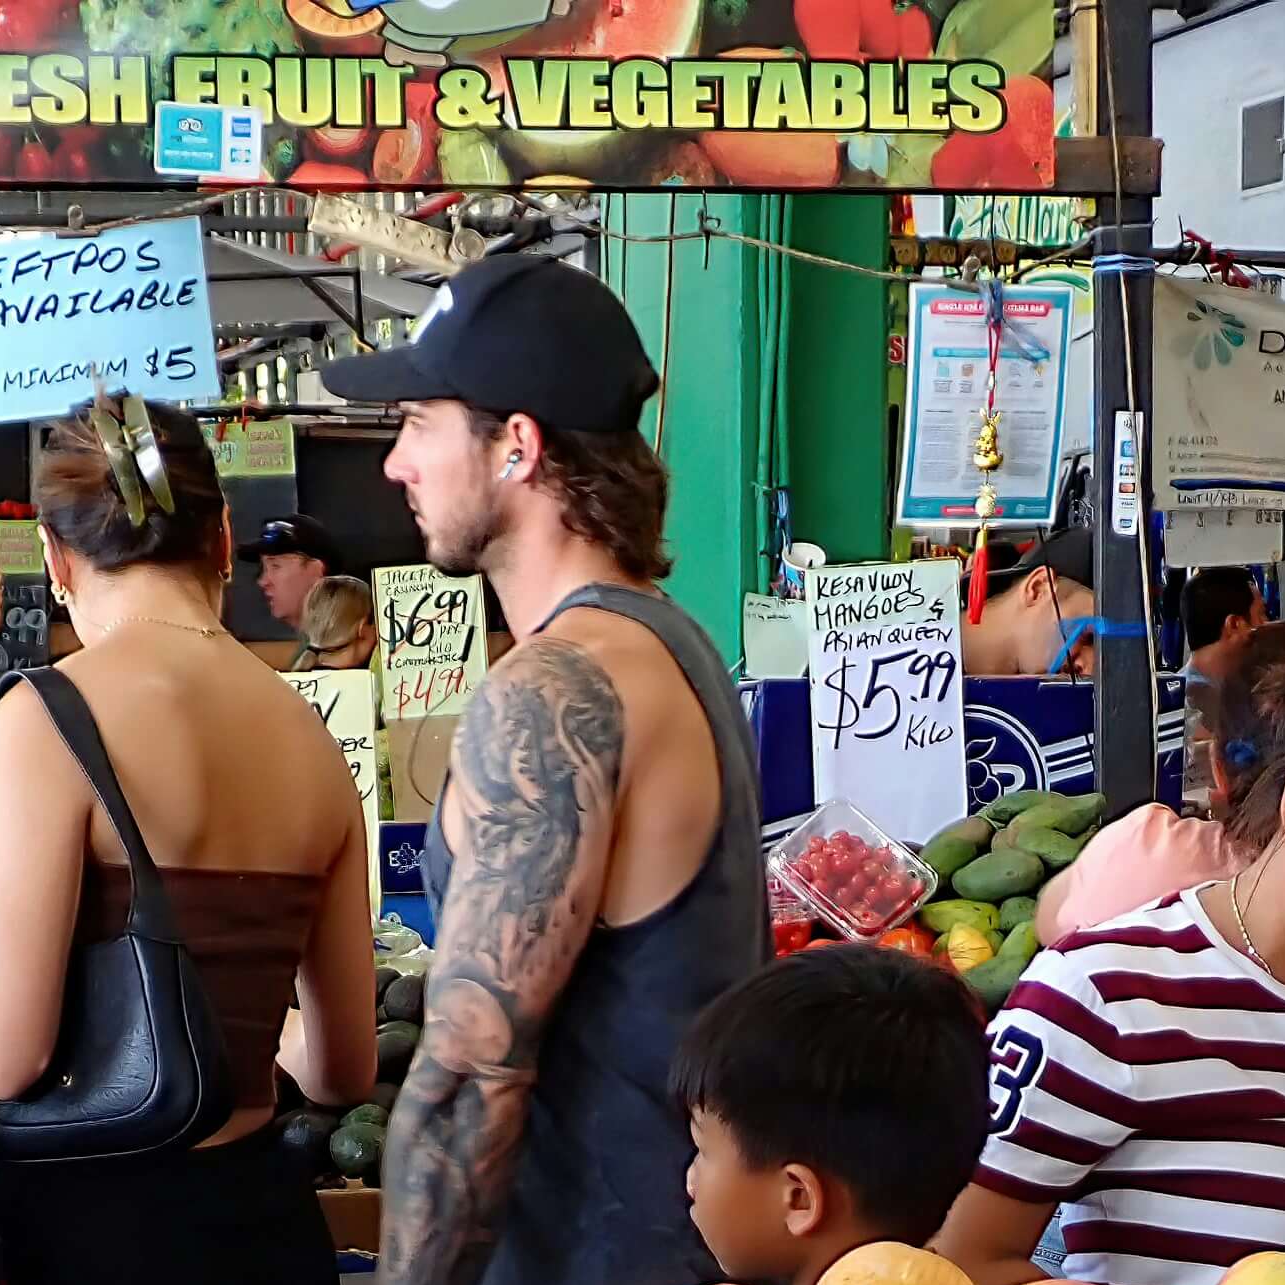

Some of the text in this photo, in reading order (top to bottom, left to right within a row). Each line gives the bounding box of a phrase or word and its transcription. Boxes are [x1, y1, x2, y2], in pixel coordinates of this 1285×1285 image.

[174, 54, 413, 126] FRUIT
[437, 69, 500, 128] &
[507, 59, 1006, 131] VEGETABLES
[3, 346, 196, 392] MINIMUM $5
[815, 588, 925, 631] MANGOES
[824, 626, 954, 652] ASIAN QUEEN
[818, 649, 957, 750] $5.99
